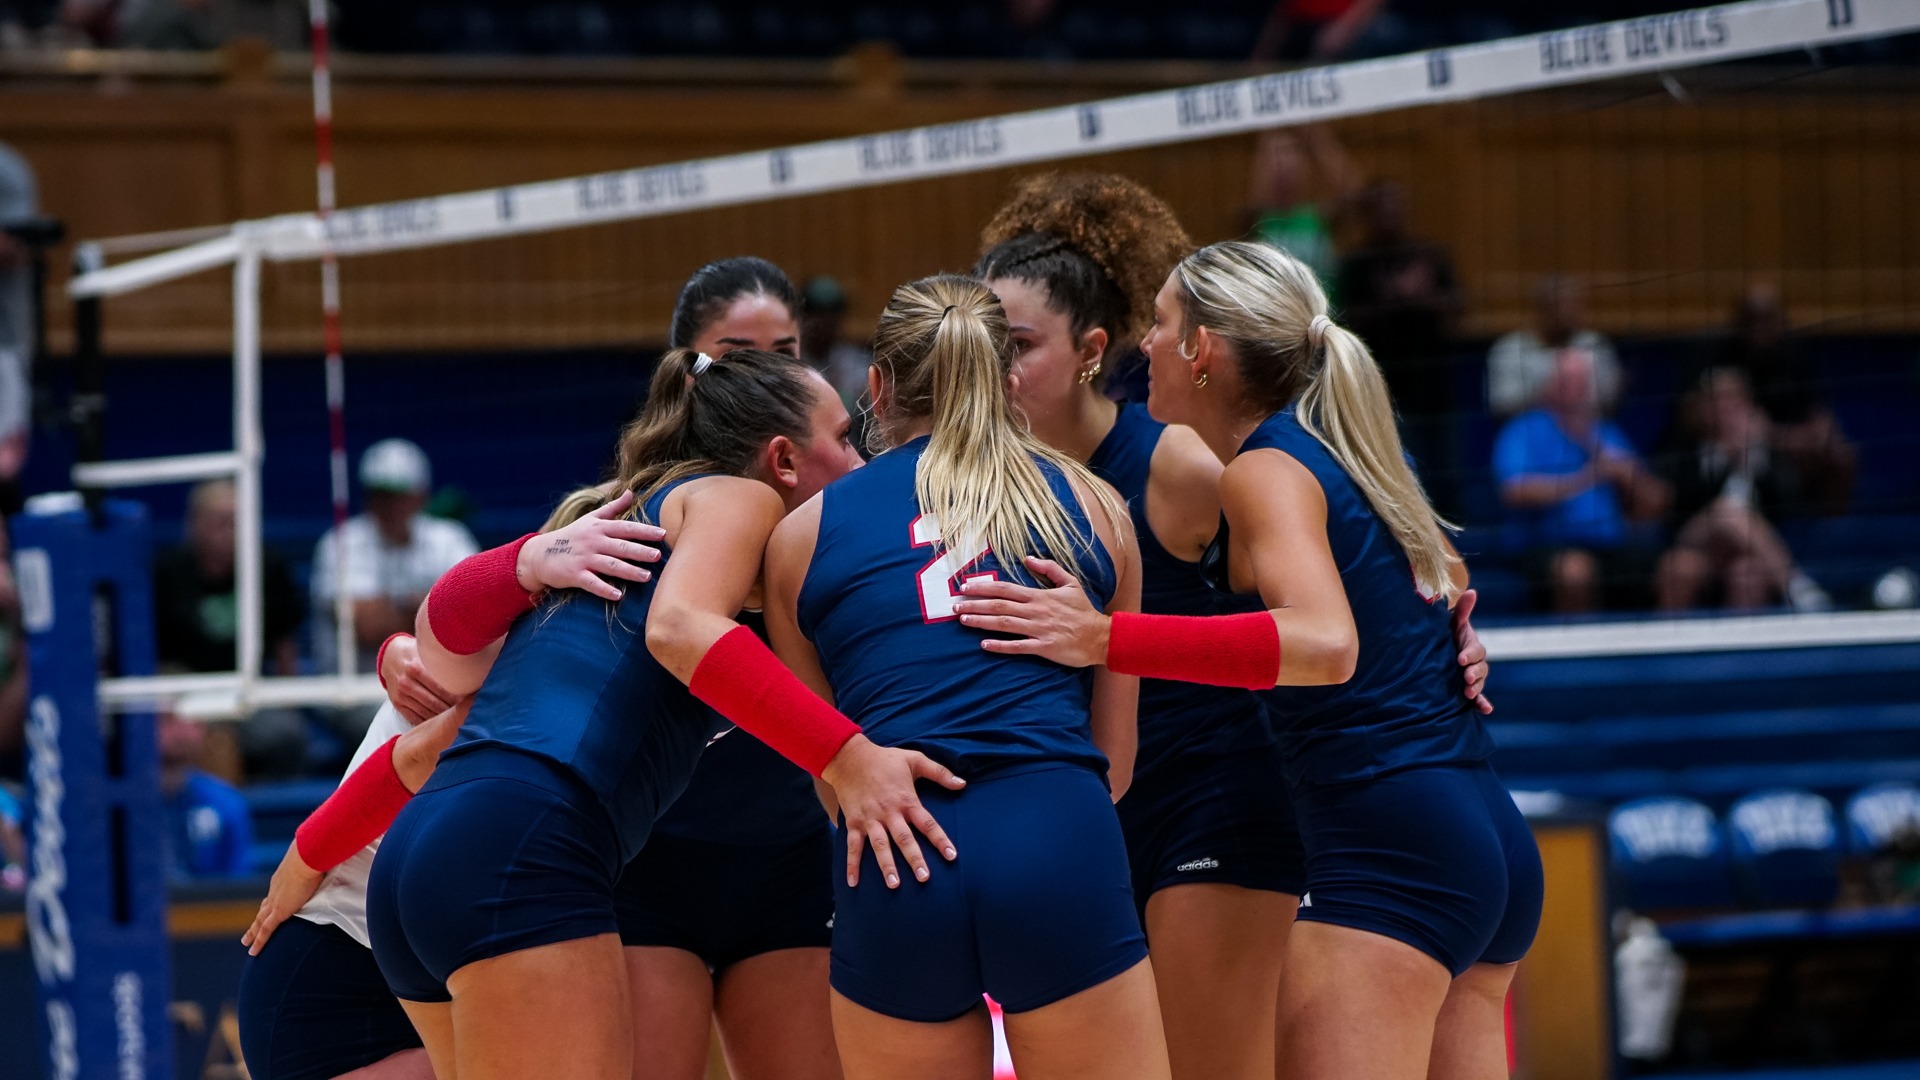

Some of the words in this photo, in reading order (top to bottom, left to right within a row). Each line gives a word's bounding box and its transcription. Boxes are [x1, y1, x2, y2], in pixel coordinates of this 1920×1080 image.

[1540, 21, 1614, 73] BLUE
[1625, 9, 1730, 58] DEVILS
[1177, 80, 1239, 127] BLUE
[1250, 66, 1341, 115] DEVILS
[908, 511, 998, 624] 2
[1177, 857, 1219, 871] adidas
